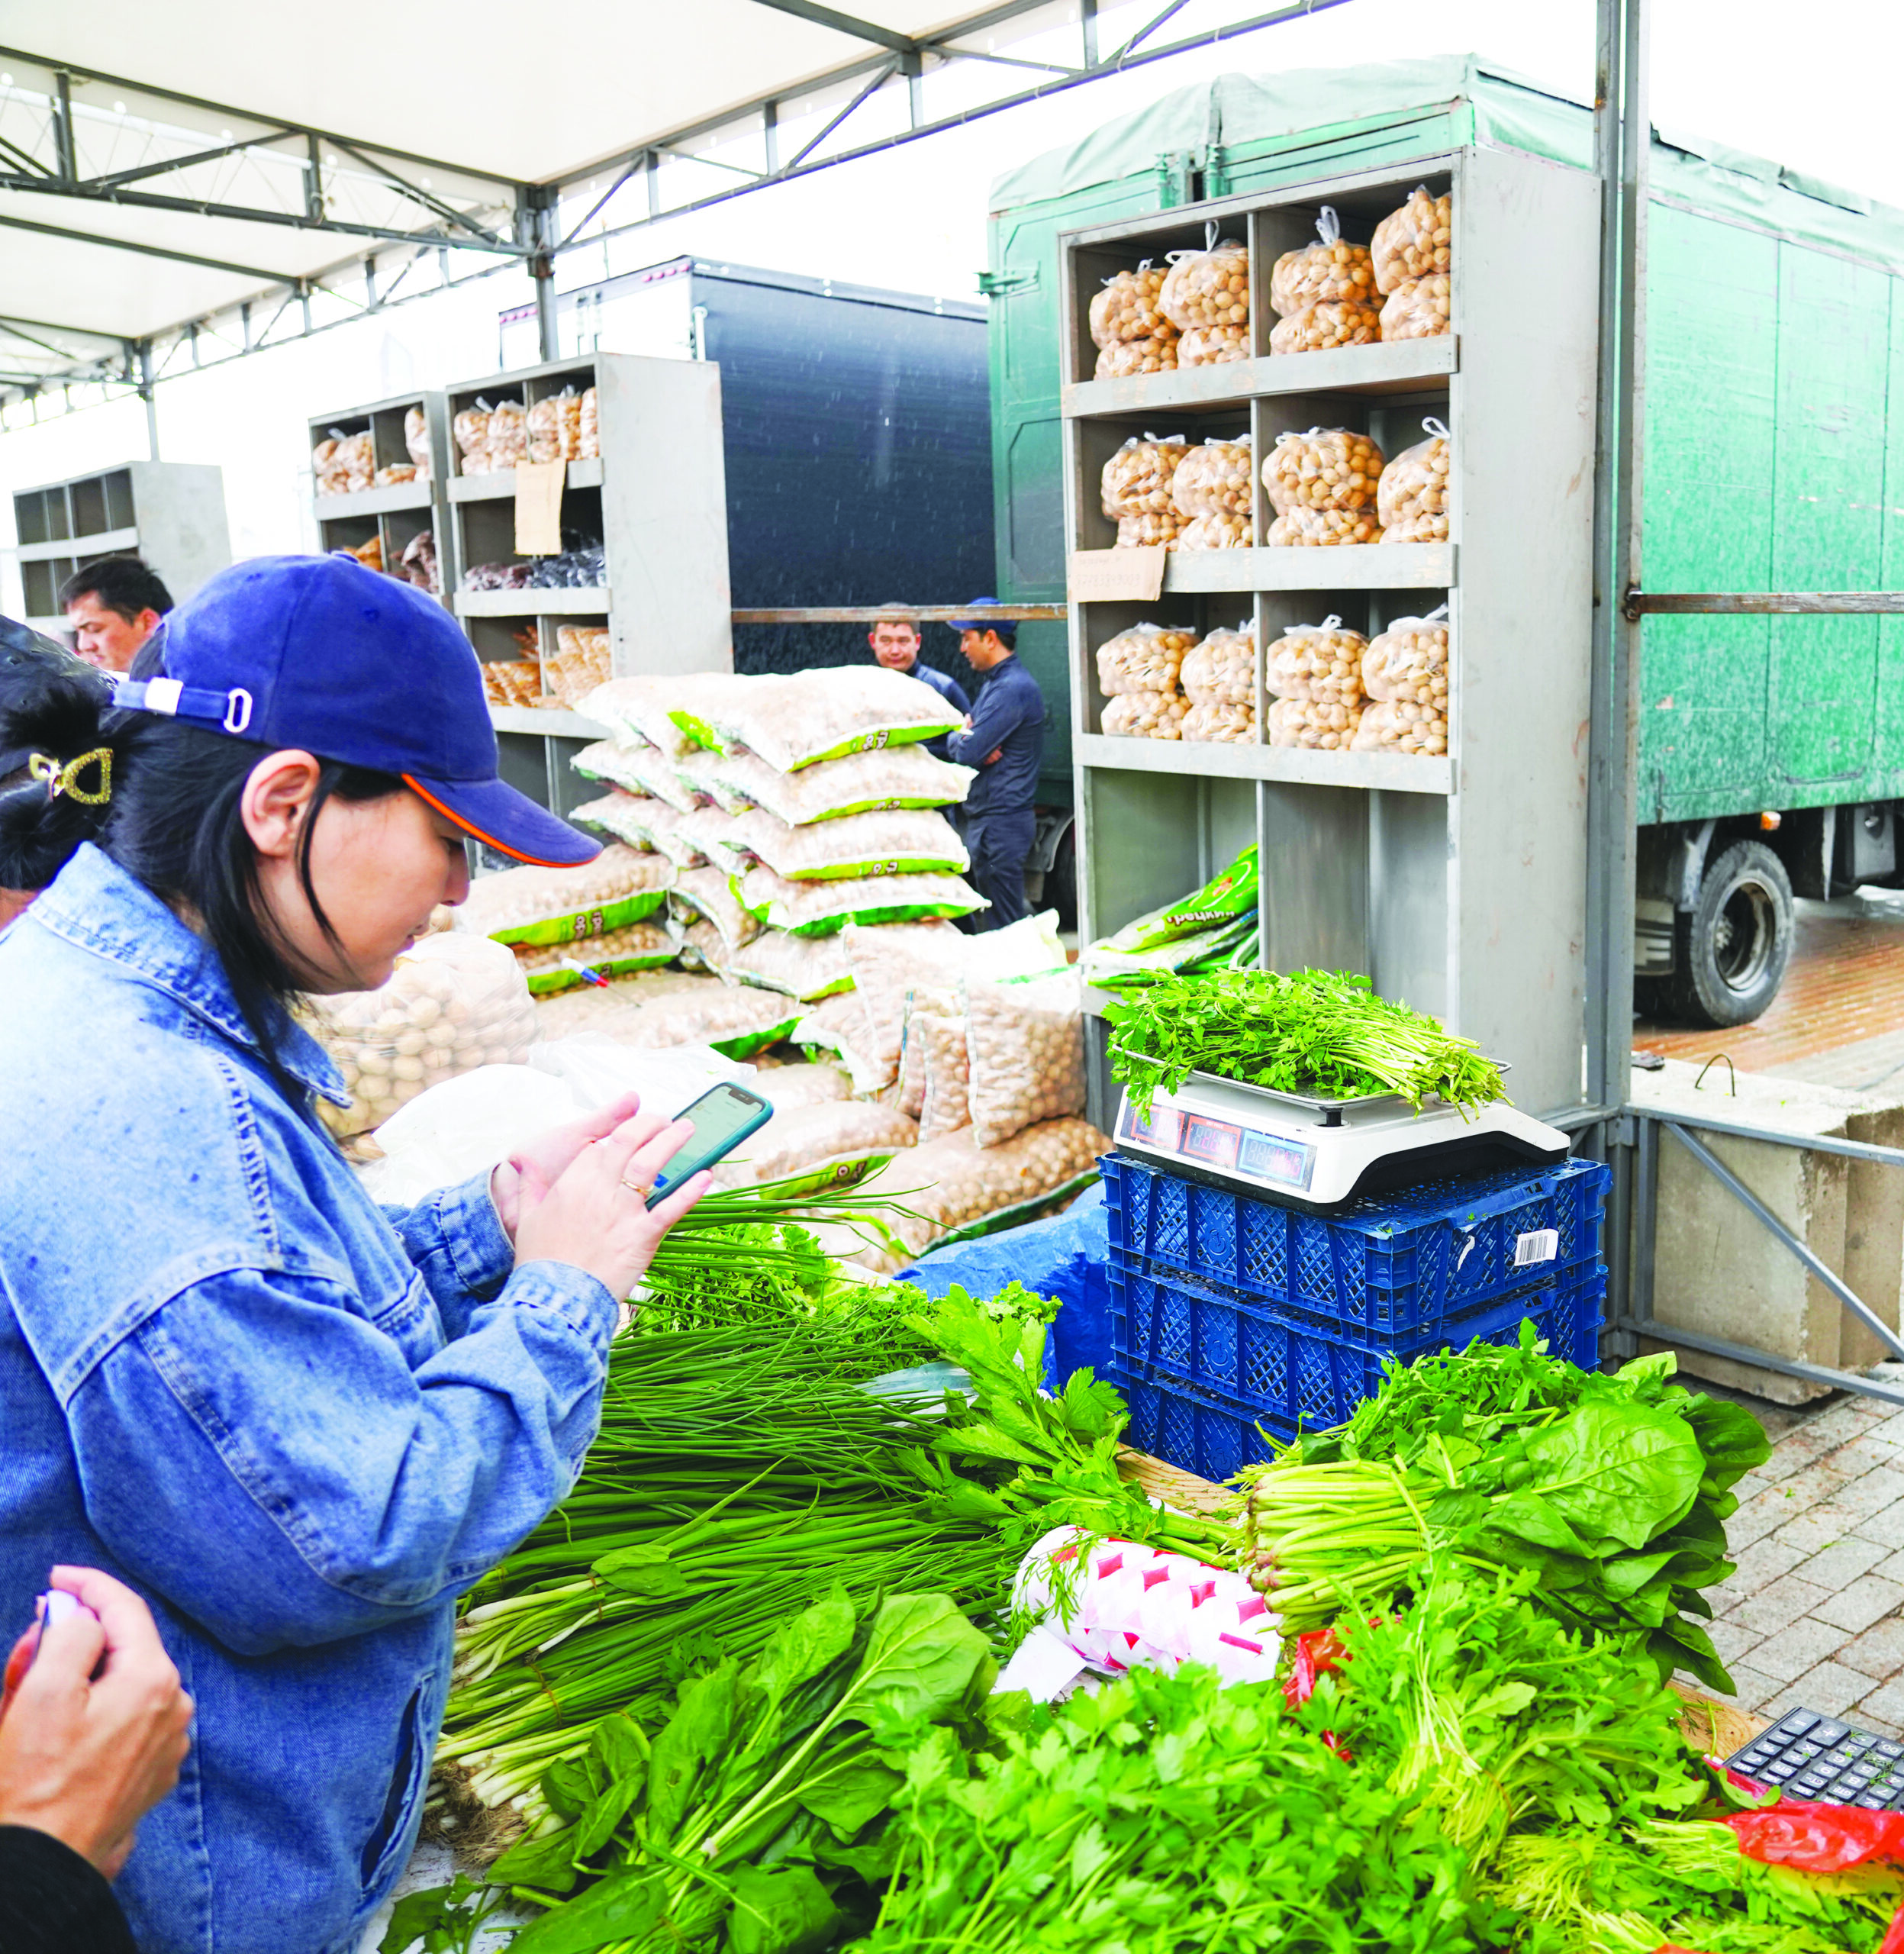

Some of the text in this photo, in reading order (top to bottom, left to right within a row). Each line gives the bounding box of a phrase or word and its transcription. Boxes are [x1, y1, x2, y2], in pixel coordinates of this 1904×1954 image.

[1167, 910, 1236, 927] рецки
[1832, 1755, 1845, 1763] 6
[1820, 1766, 1832, 1775] 9
[1848, 1776, 1861, 1785] 8
